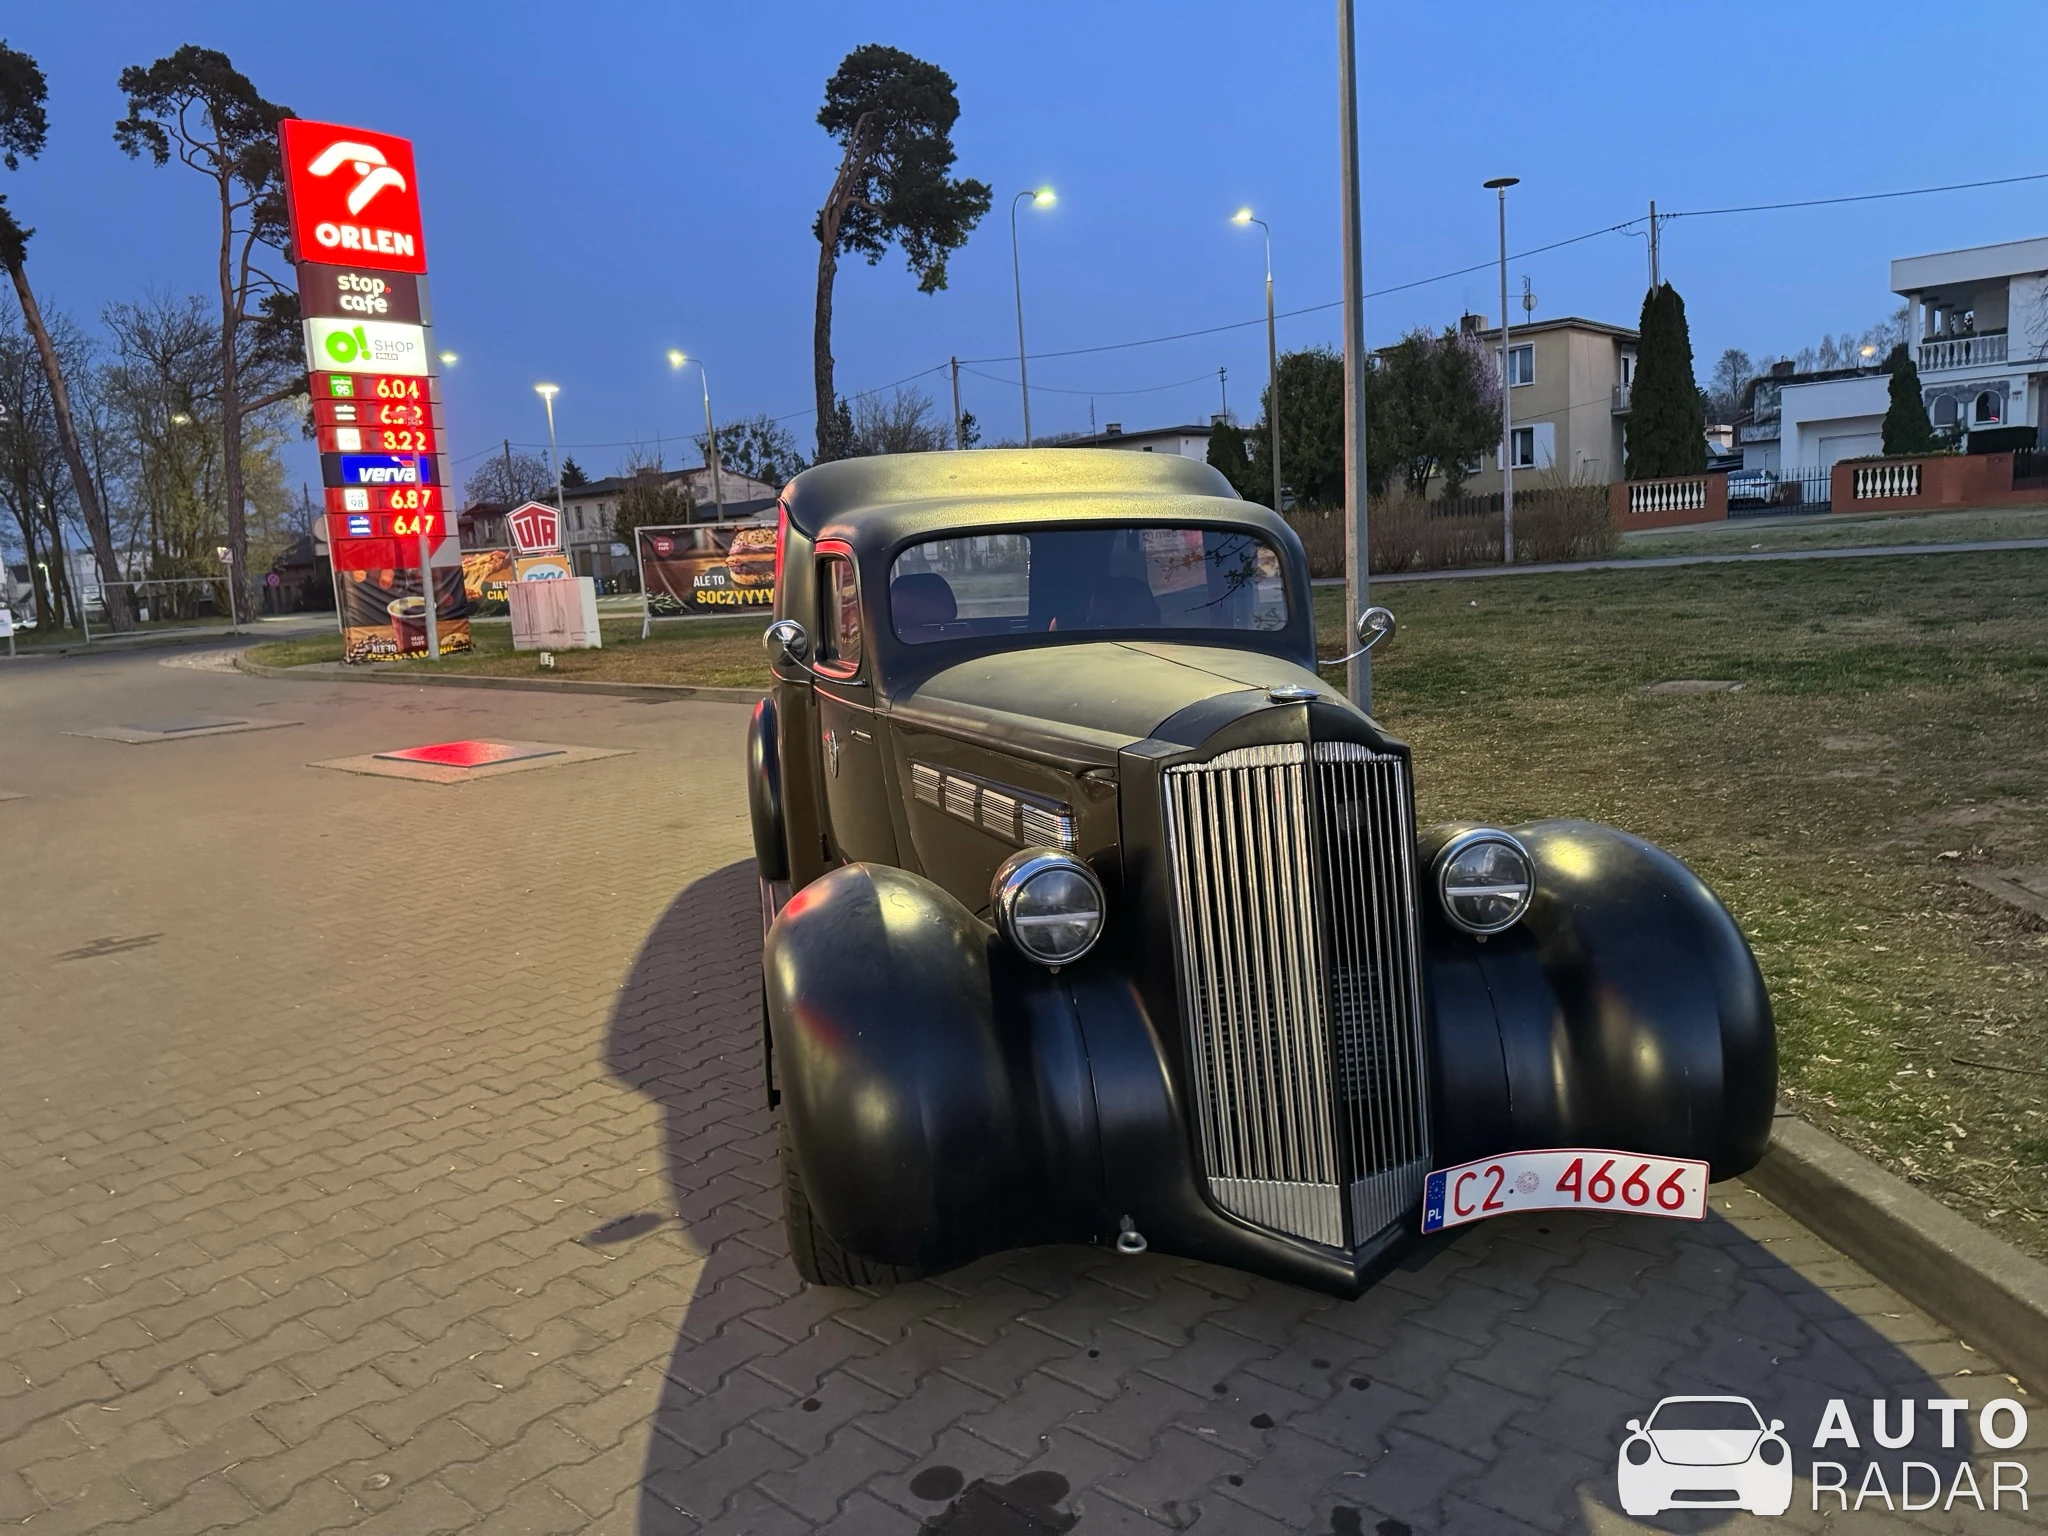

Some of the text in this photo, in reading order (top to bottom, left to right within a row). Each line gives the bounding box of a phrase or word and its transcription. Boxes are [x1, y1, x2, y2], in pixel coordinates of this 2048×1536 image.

[315, 223, 414, 256] ORLEN
[340, 294, 387, 314] cafe
[375, 340, 414, 352] SHOP
[335, 385, 350, 395] 95
[377, 379, 420, 399] 6.04
[383, 431, 427, 450] 3.22
[358, 467, 416, 482] verva
[350, 500, 364, 508] 98
[391, 490, 431, 509] 6.87
[394, 515, 434, 535] 6.47
[513, 507, 556, 548] UTA
[492, 581, 503, 589] ALE
[693, 575, 725, 587] ALE TO
[1454, 1158, 1686, 1216] C2 4666
[1428, 1210, 1441, 1222] PL
